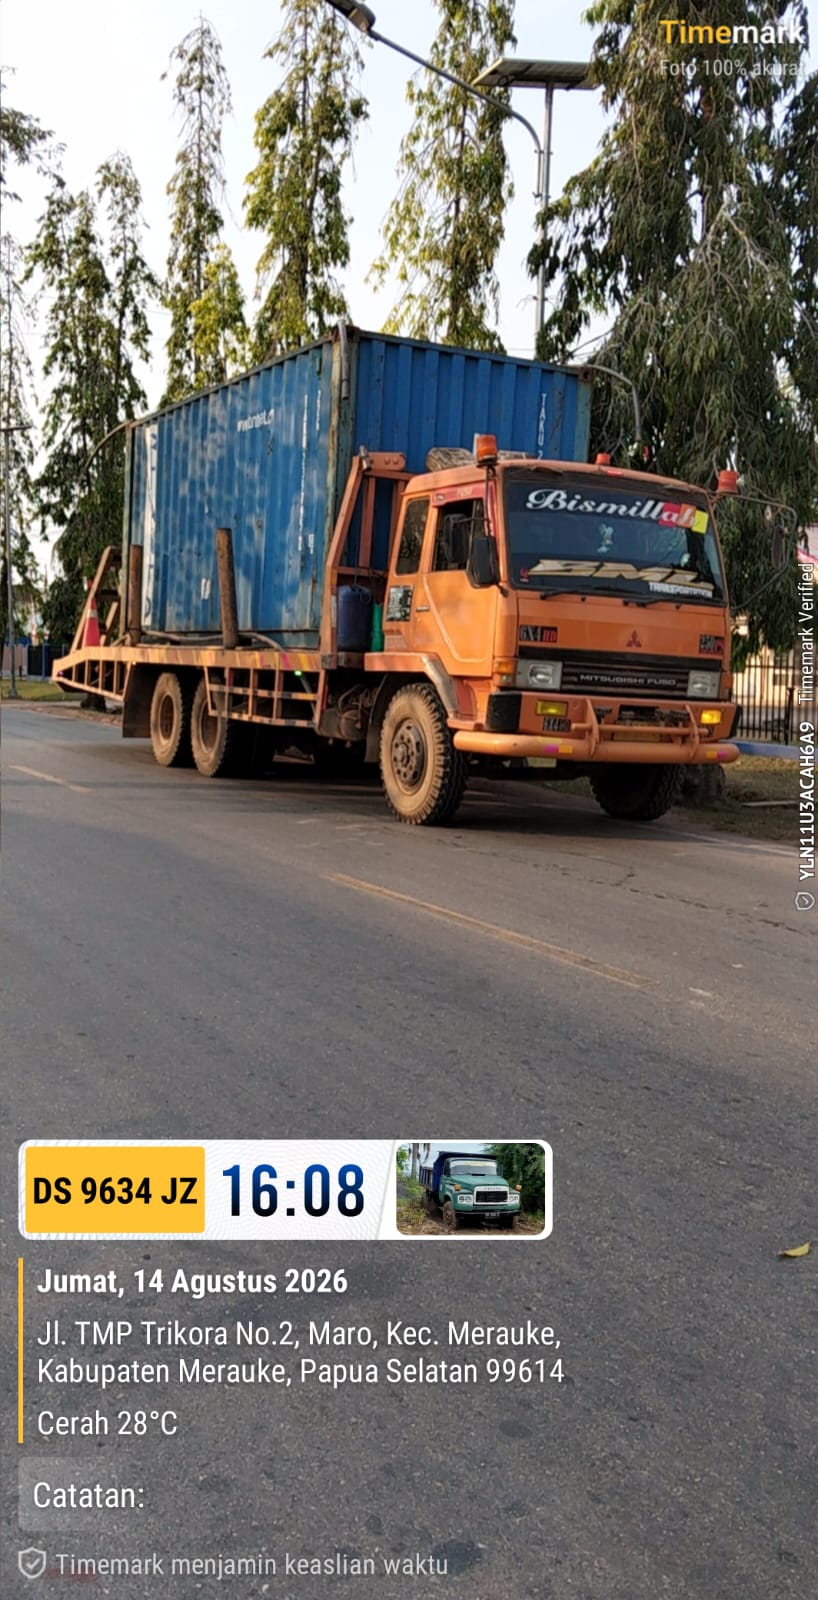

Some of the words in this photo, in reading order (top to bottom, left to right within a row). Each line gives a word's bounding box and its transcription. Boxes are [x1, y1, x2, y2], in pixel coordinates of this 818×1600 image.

[525, 489, 697, 527] Bismillah
[580, 674, 644, 685] MITSUBISHI
[647, 678, 676, 686] FUSO
